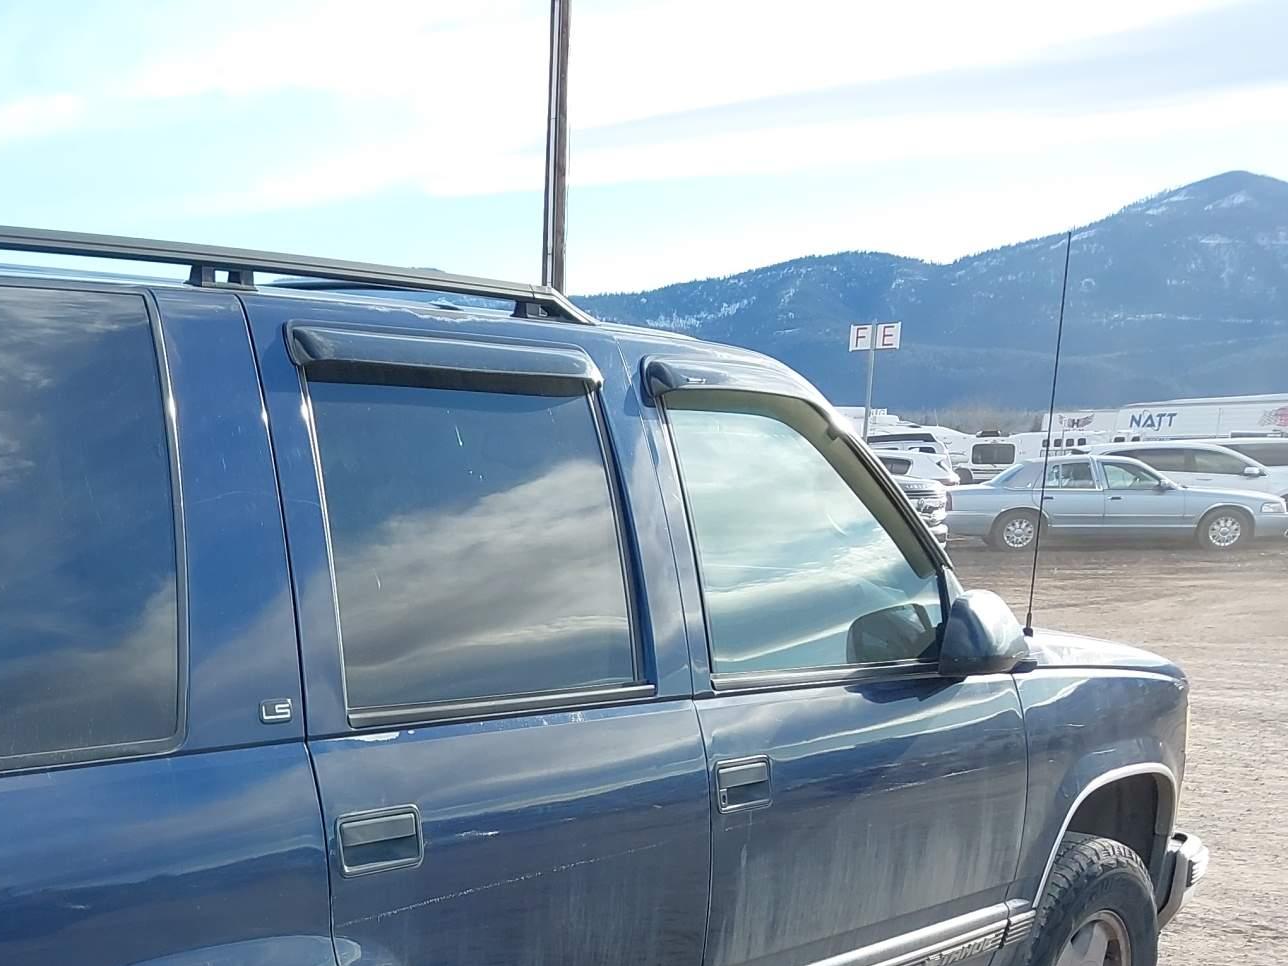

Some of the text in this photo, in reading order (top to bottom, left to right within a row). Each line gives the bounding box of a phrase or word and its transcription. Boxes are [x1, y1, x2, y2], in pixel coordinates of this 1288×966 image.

[855, 325, 895, 348] F E
[1129, 411, 1178, 431] NATT
[262, 703, 291, 720] LS
